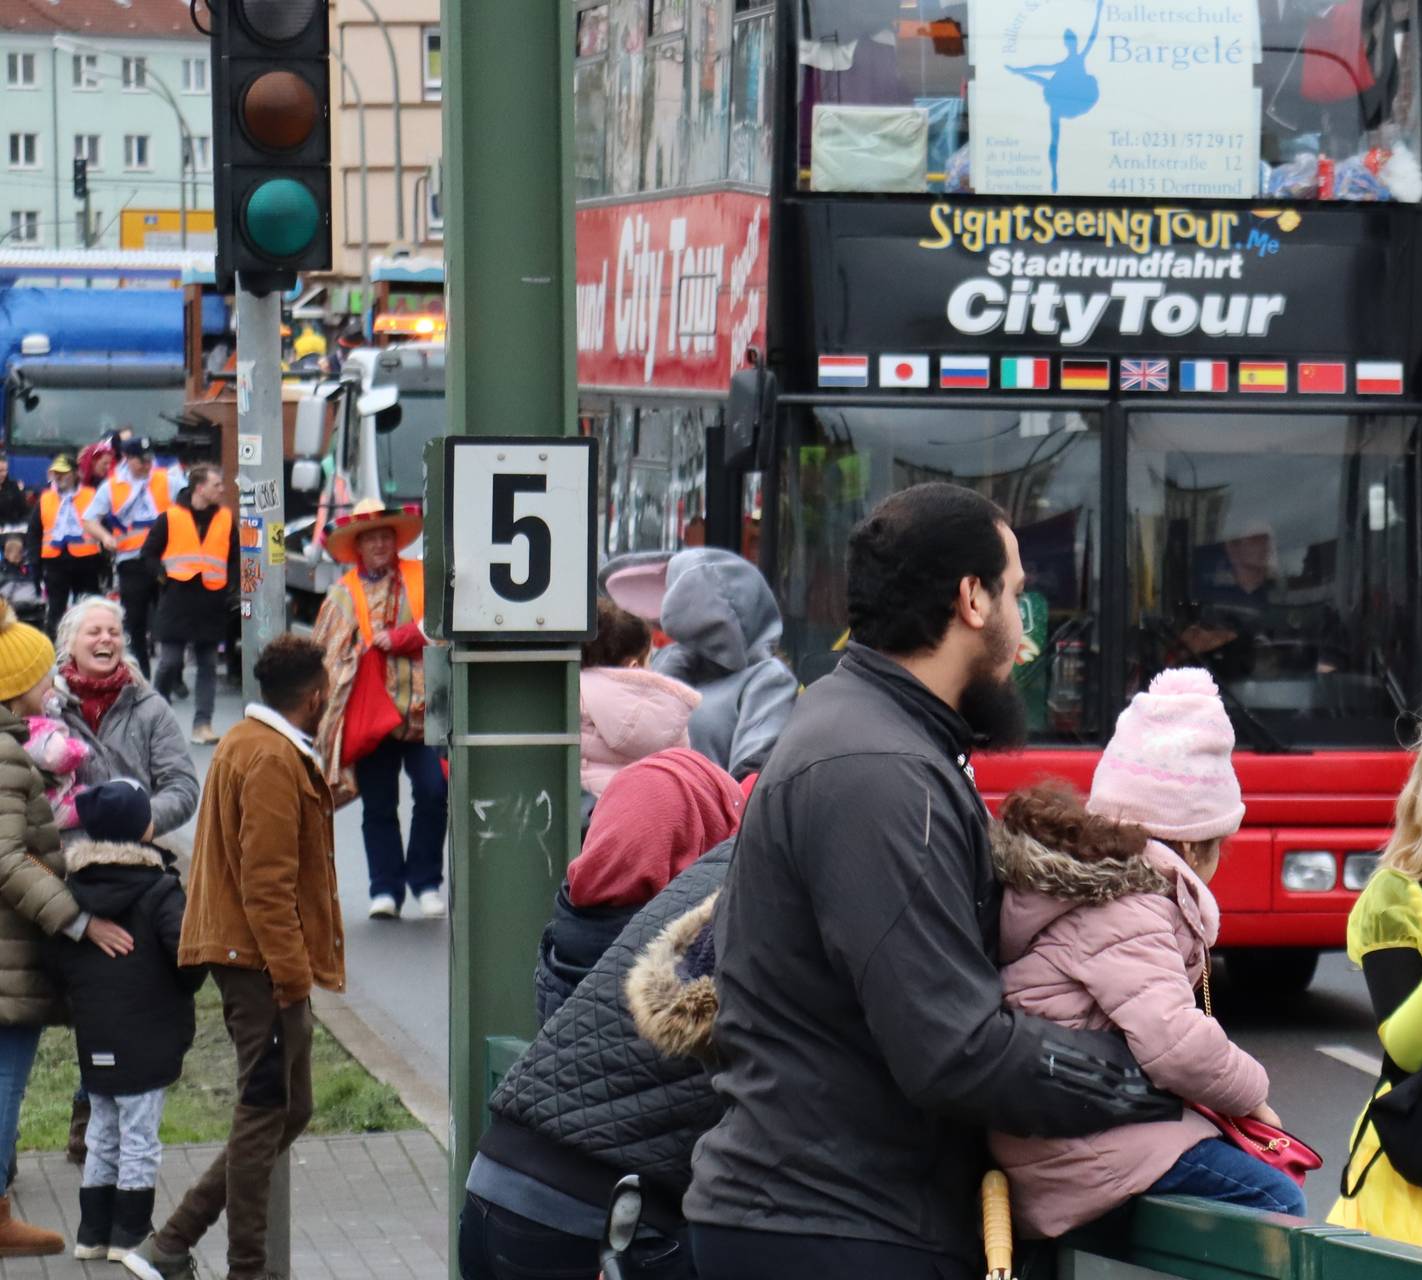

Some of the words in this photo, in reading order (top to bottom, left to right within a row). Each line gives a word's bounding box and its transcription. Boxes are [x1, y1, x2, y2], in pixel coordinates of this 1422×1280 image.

[1105, 4, 1243, 24] Ballettschule
[1106, 34, 1243, 71] Bargelé
[1108, 130, 1139, 147] Tel.:
[1142, 131, 1177, 148] 0231
[1108, 152, 1208, 170] Arndtstraße
[1225, 155, 1243, 171] 12
[1107, 177, 1156, 193] 44135
[1161, 177, 1243, 194] Dortmund
[986, 249, 1244, 279] Stadtrundfahrt
[614, 213, 664, 384] City
[668, 216, 725, 358] Tour
[489, 473, 552, 603] 5
